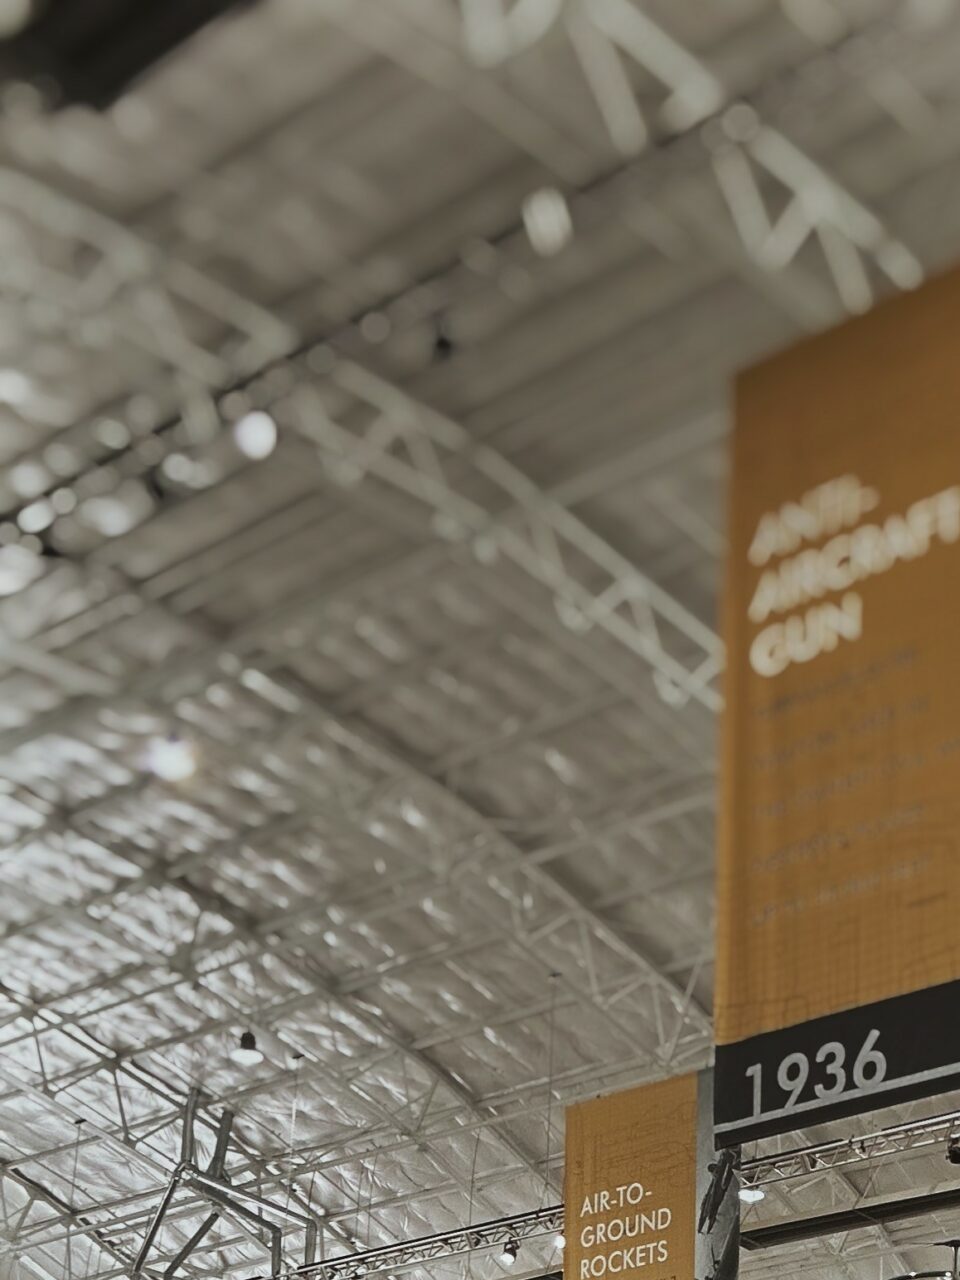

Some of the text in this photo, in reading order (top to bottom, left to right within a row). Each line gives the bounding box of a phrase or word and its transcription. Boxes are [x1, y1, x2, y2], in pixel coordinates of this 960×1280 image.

[746, 471, 881, 568] ANTI-
[748, 591, 864, 679] GUN
[744, 1028, 889, 1119] 1936
[579, 1181, 653, 1219] AIR-TO-
[580, 1206, 672, 1250] GROUND
[579, 1240, 669, 1280] ROCKETS
